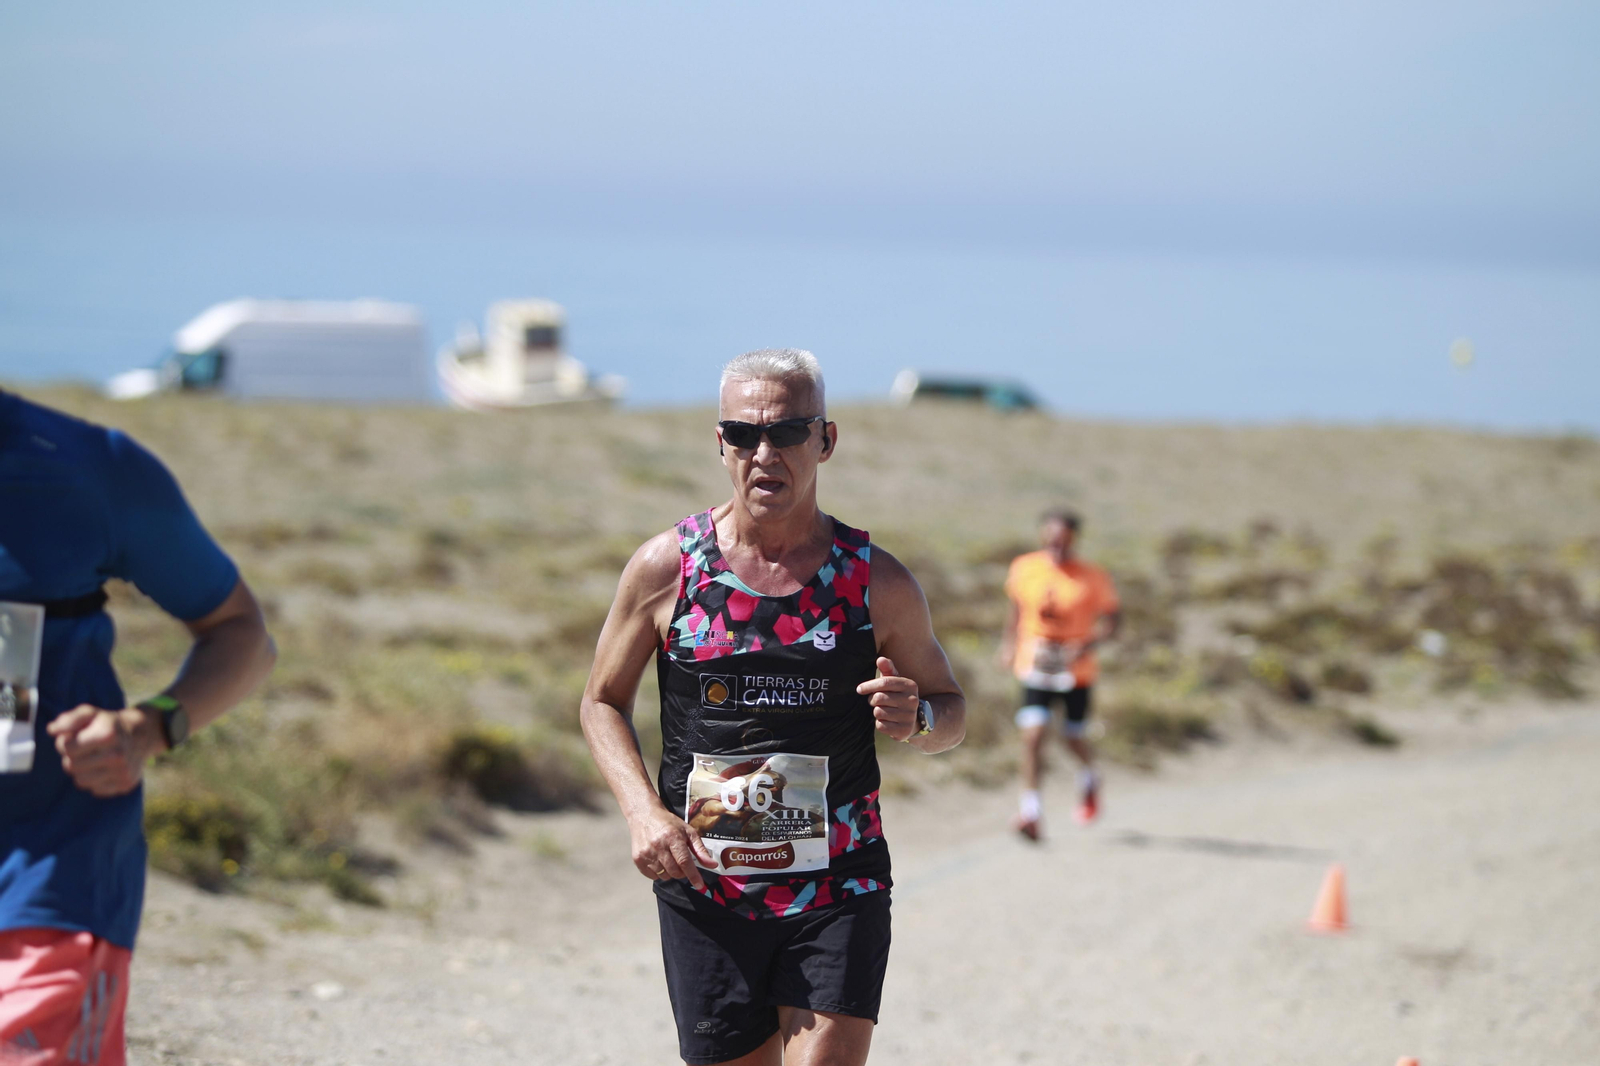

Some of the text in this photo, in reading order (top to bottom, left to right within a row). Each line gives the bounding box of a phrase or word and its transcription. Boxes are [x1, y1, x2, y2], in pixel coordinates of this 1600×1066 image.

[742, 675, 830, 690] TIERRAS DE
[742, 688, 825, 706] CANENA
[721, 773, 774, 813] 66
[762, 809, 811, 820] XIII
